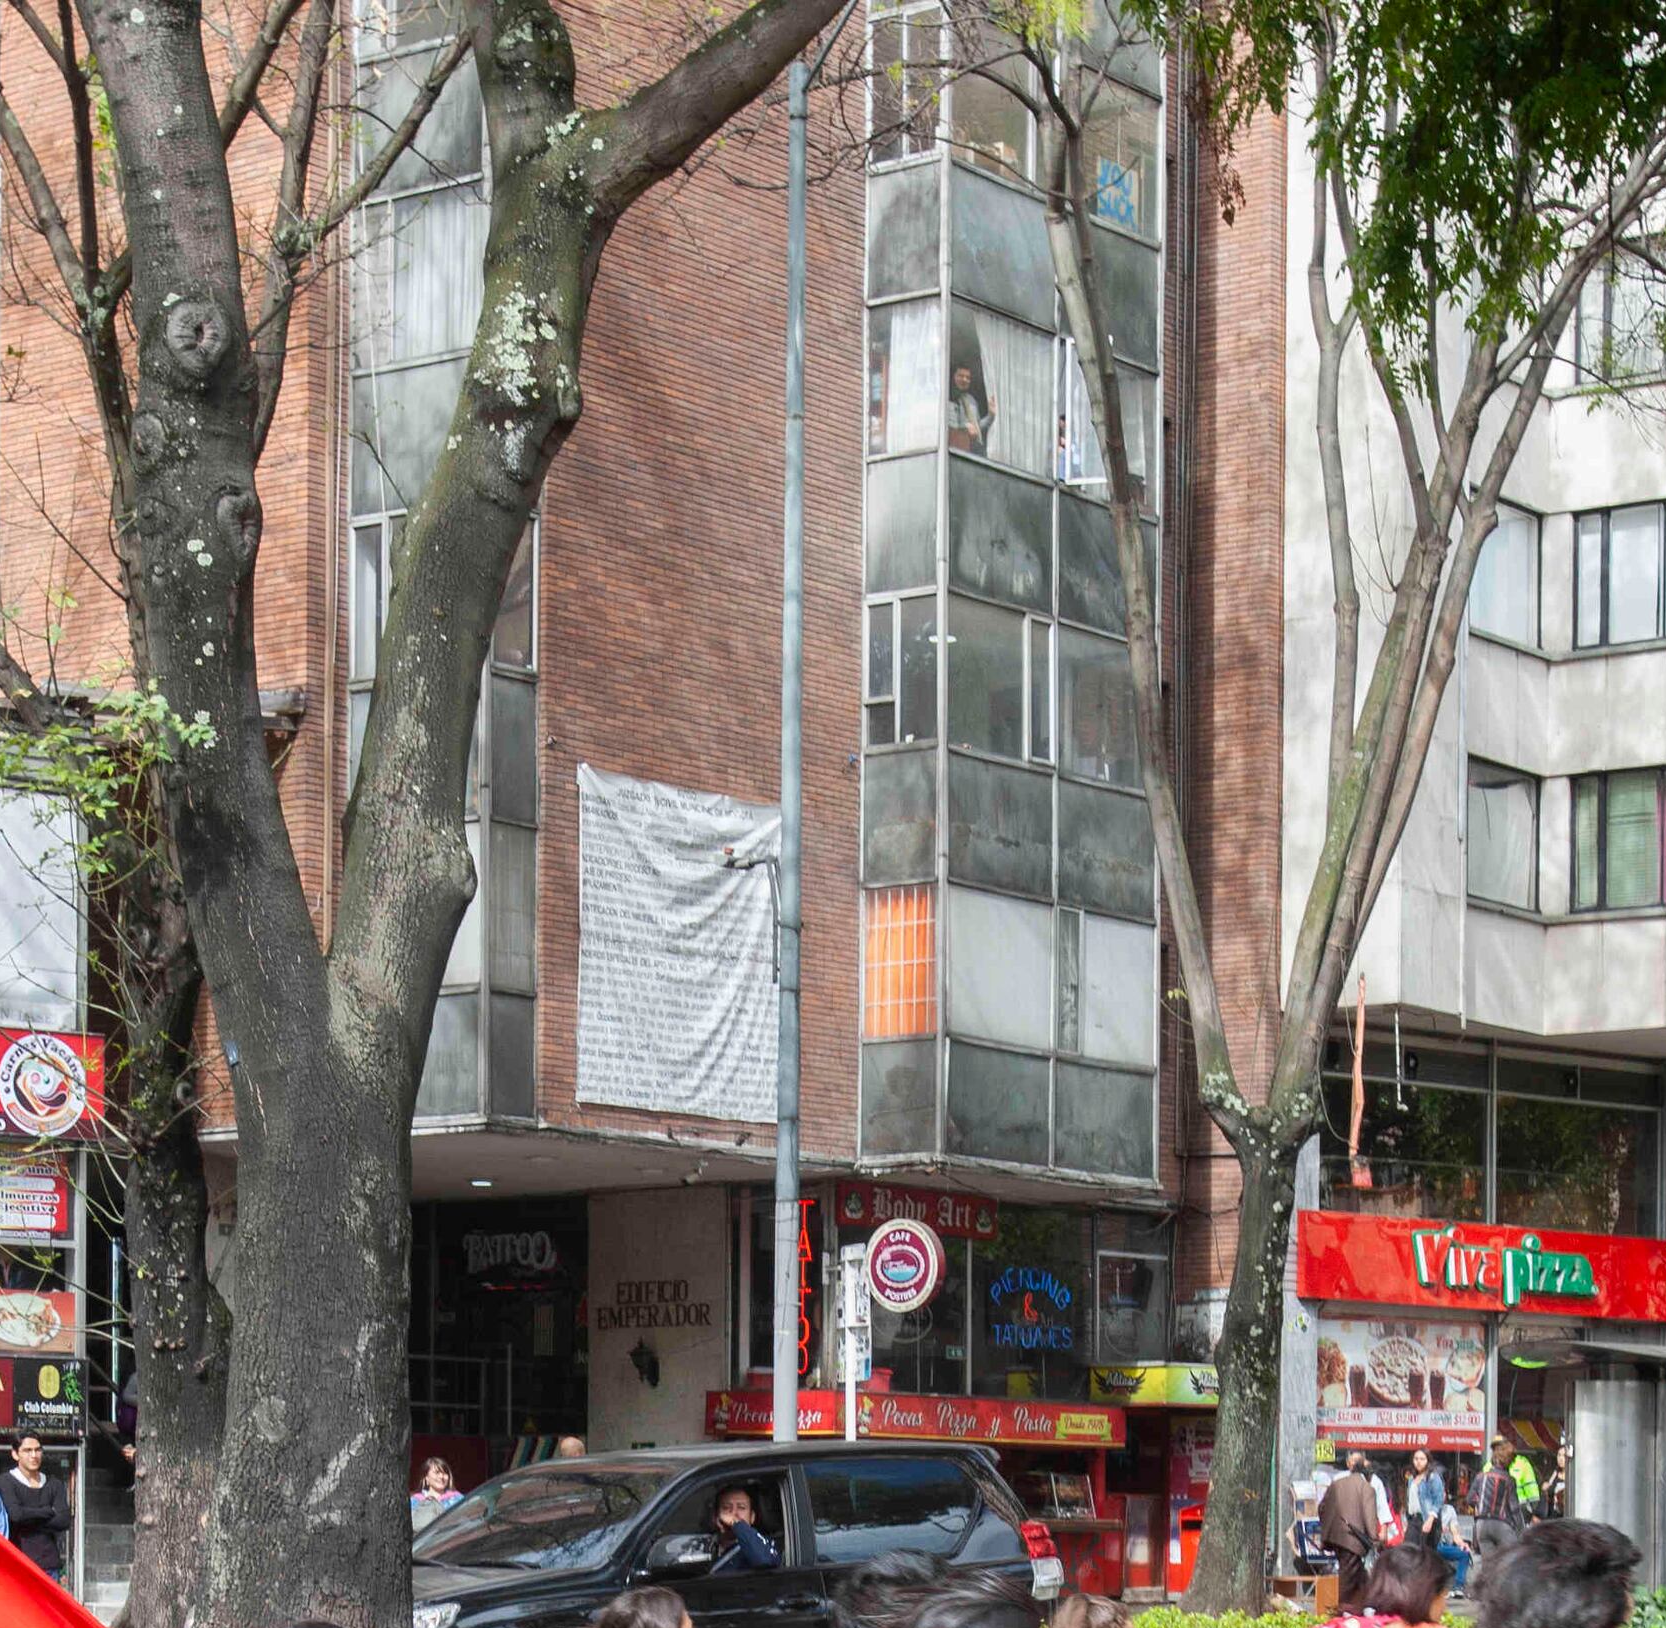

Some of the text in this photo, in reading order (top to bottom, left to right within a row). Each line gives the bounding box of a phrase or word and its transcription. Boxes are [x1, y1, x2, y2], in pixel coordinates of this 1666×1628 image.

[873, 1187, 973, 1230] Body Art
[462, 1230, 557, 1274] TATTOO
[889, 1230, 911, 1243] CAFE
[1413, 1224, 1599, 1307] Viva pizza
[616, 1279, 690, 1305] EDIFICIO
[990, 1267, 1073, 1312] PIERCING
[595, 1303, 712, 1330] EMPERADOR
[1024, 1291, 1038, 1323] &
[993, 1323, 1074, 1349] TATUAJES
[797, 1407, 823, 1430] zza
[936, 1400, 977, 1436] Pizza
[985, 1416, 1001, 1438] y
[1013, 1405, 1053, 1434] Pasta
[1347, 1431, 1391, 1444] DOMICILIOS
